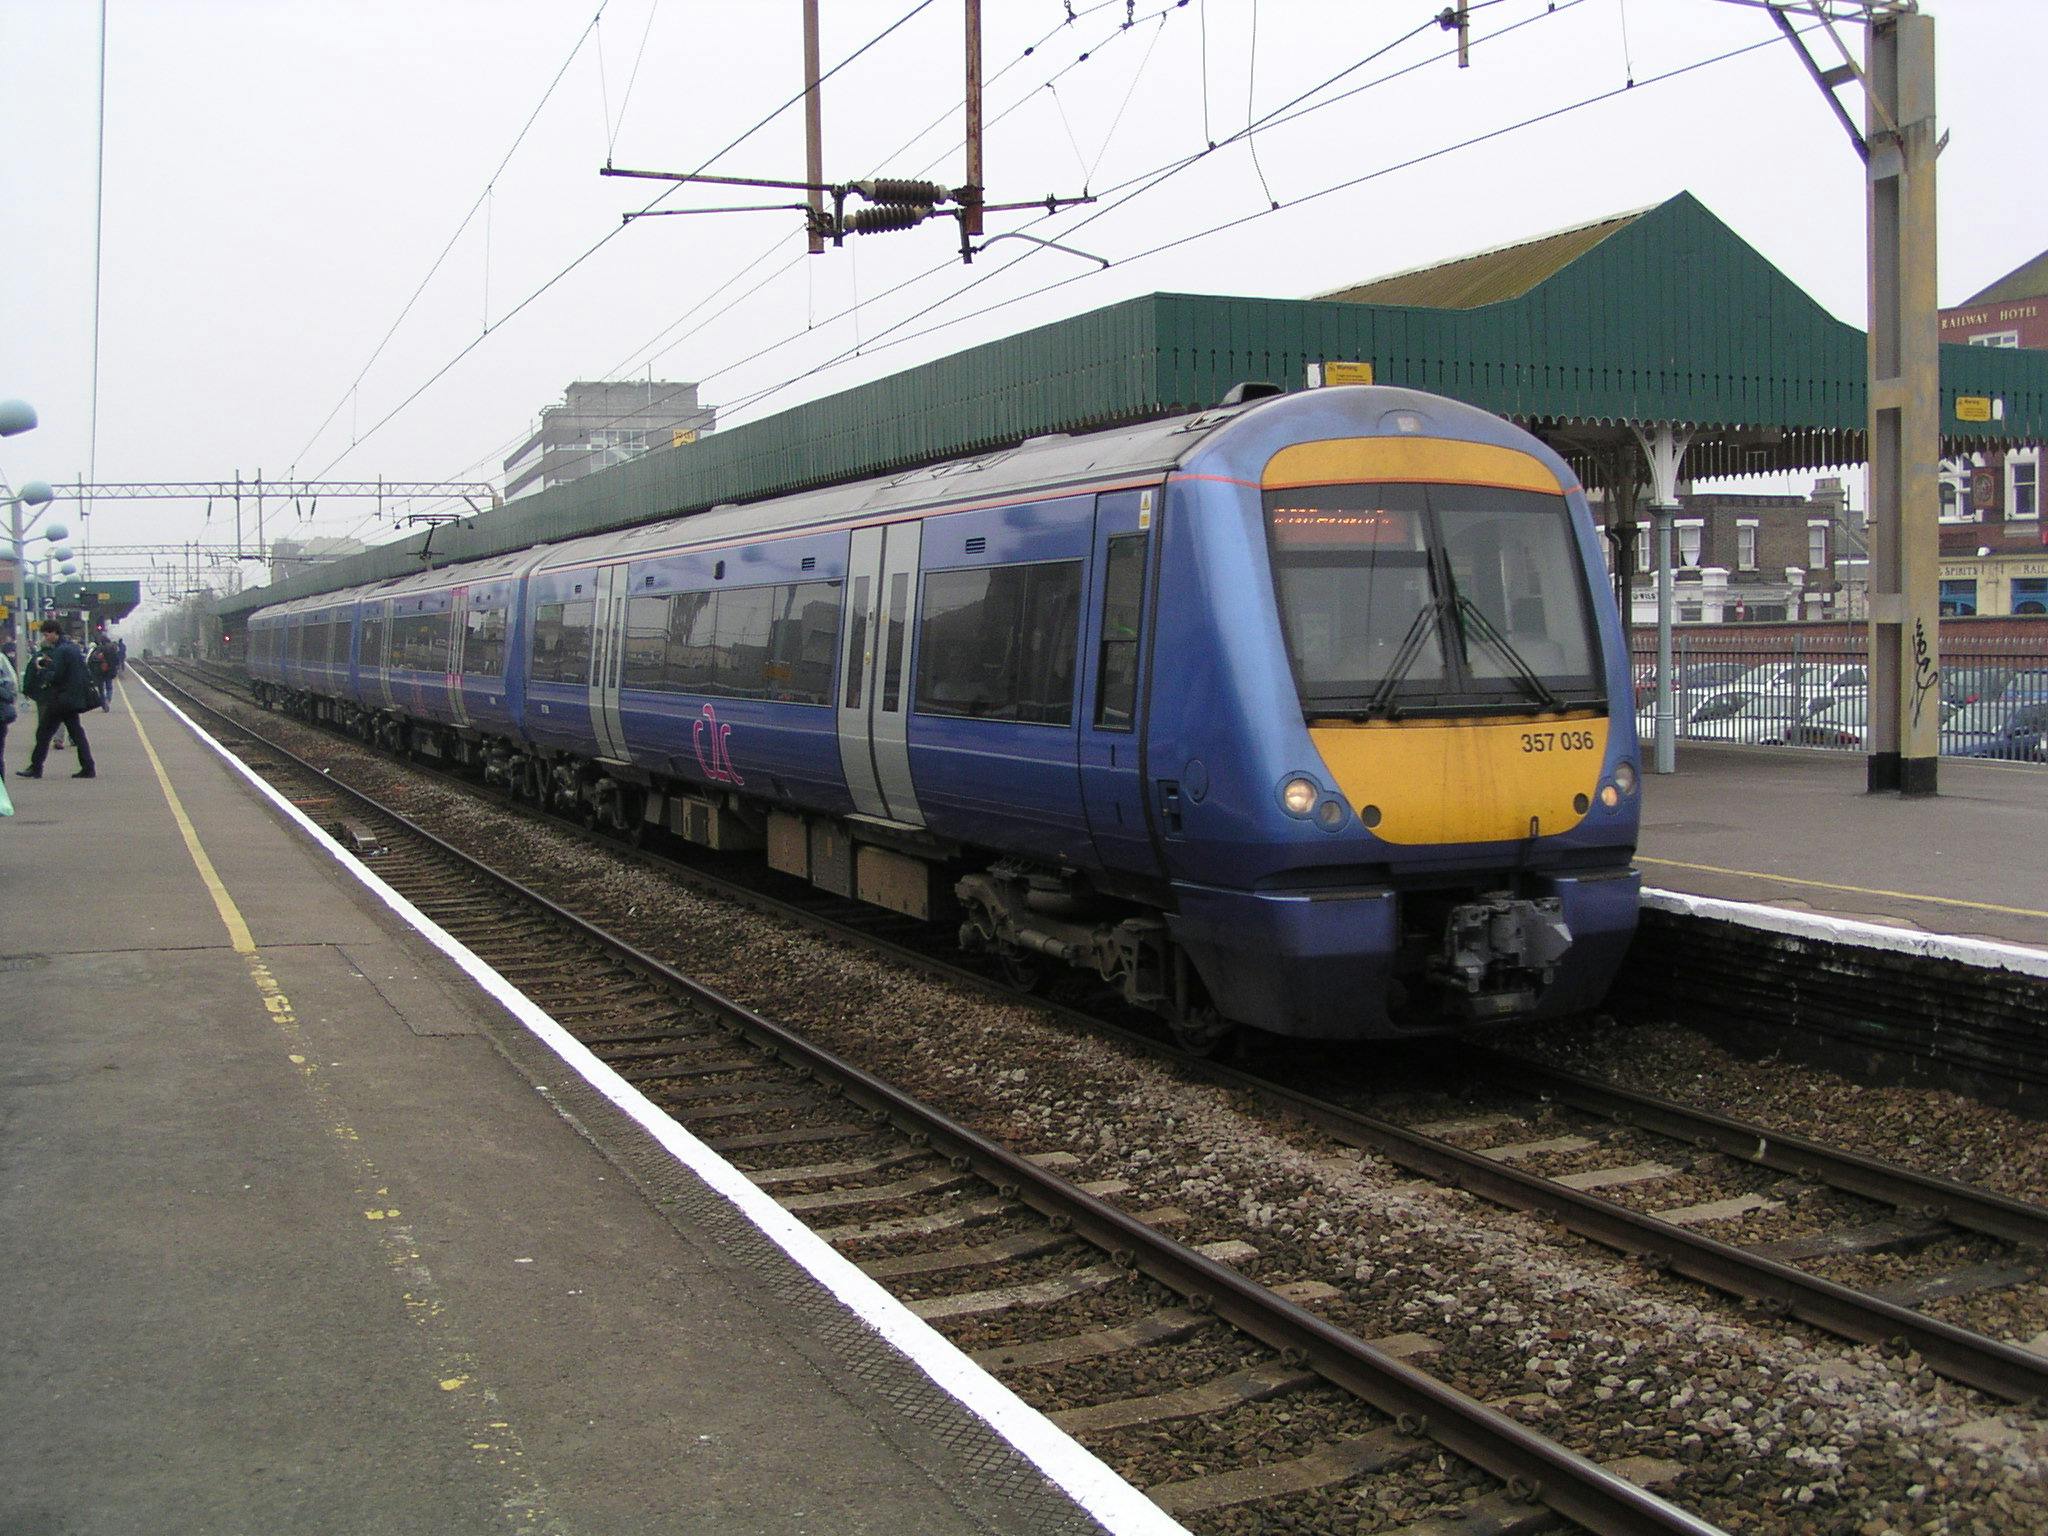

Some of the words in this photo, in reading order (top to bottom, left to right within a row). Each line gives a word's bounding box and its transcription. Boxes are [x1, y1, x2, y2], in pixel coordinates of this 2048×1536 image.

[1941, 313, 1989, 330] RAILWAY
[2000, 306, 2038, 321] HOTEL
[1945, 566, 1978, 575] SPIRITS
[45, 598, 54, 610] 2
[1521, 733, 1555, 753] 357
[1560, 731, 1594, 751] 036
